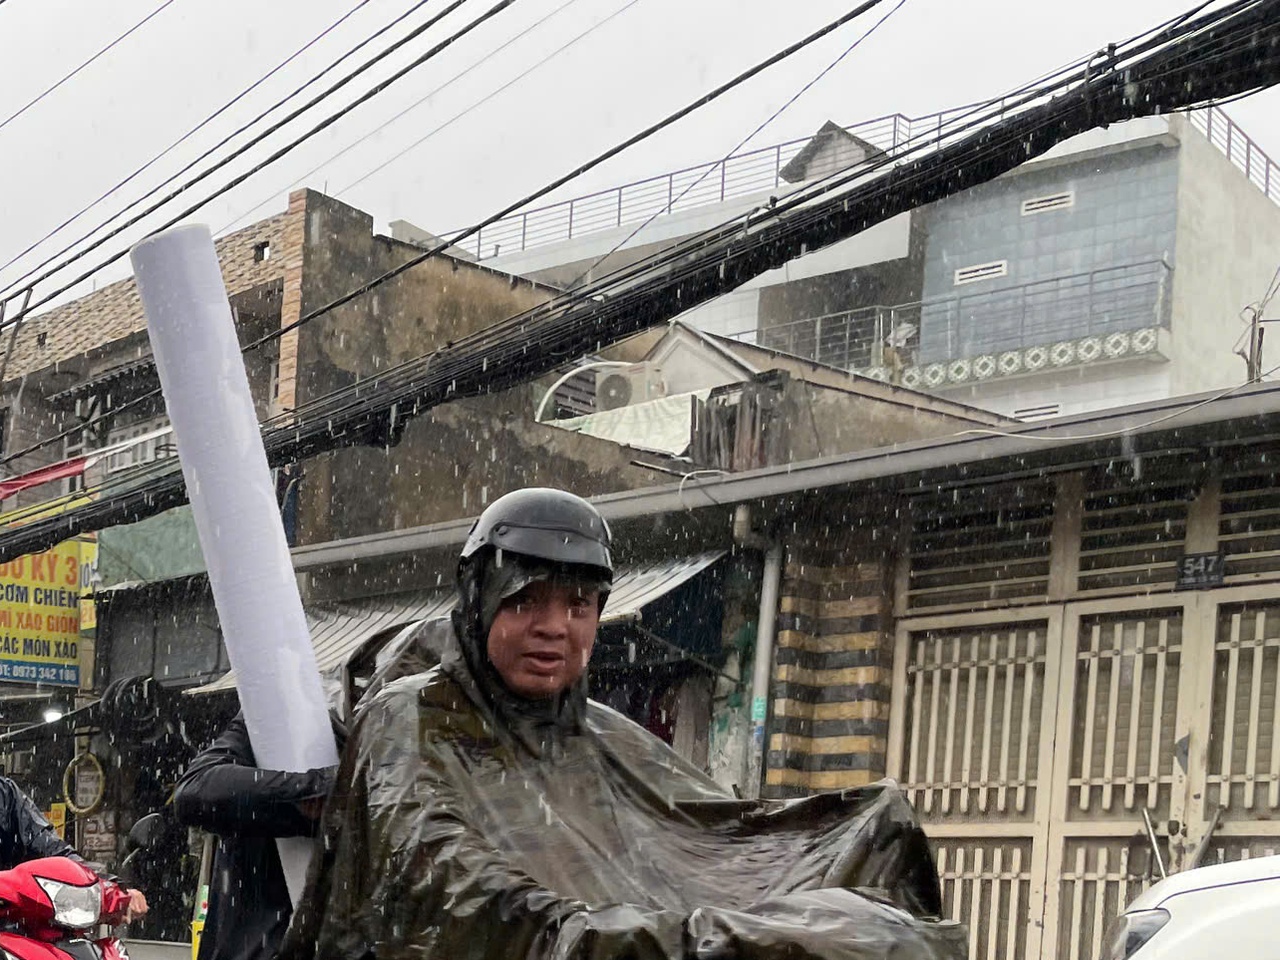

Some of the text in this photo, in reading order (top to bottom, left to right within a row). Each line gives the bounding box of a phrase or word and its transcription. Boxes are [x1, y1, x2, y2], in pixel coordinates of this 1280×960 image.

[65, 556, 77, 585] 3
[1184, 556, 1217, 575] 547
[34, 586, 78, 608] CHIÊN
[23, 635, 50, 657] MÓN
[12, 665, 37, 679] 0973
